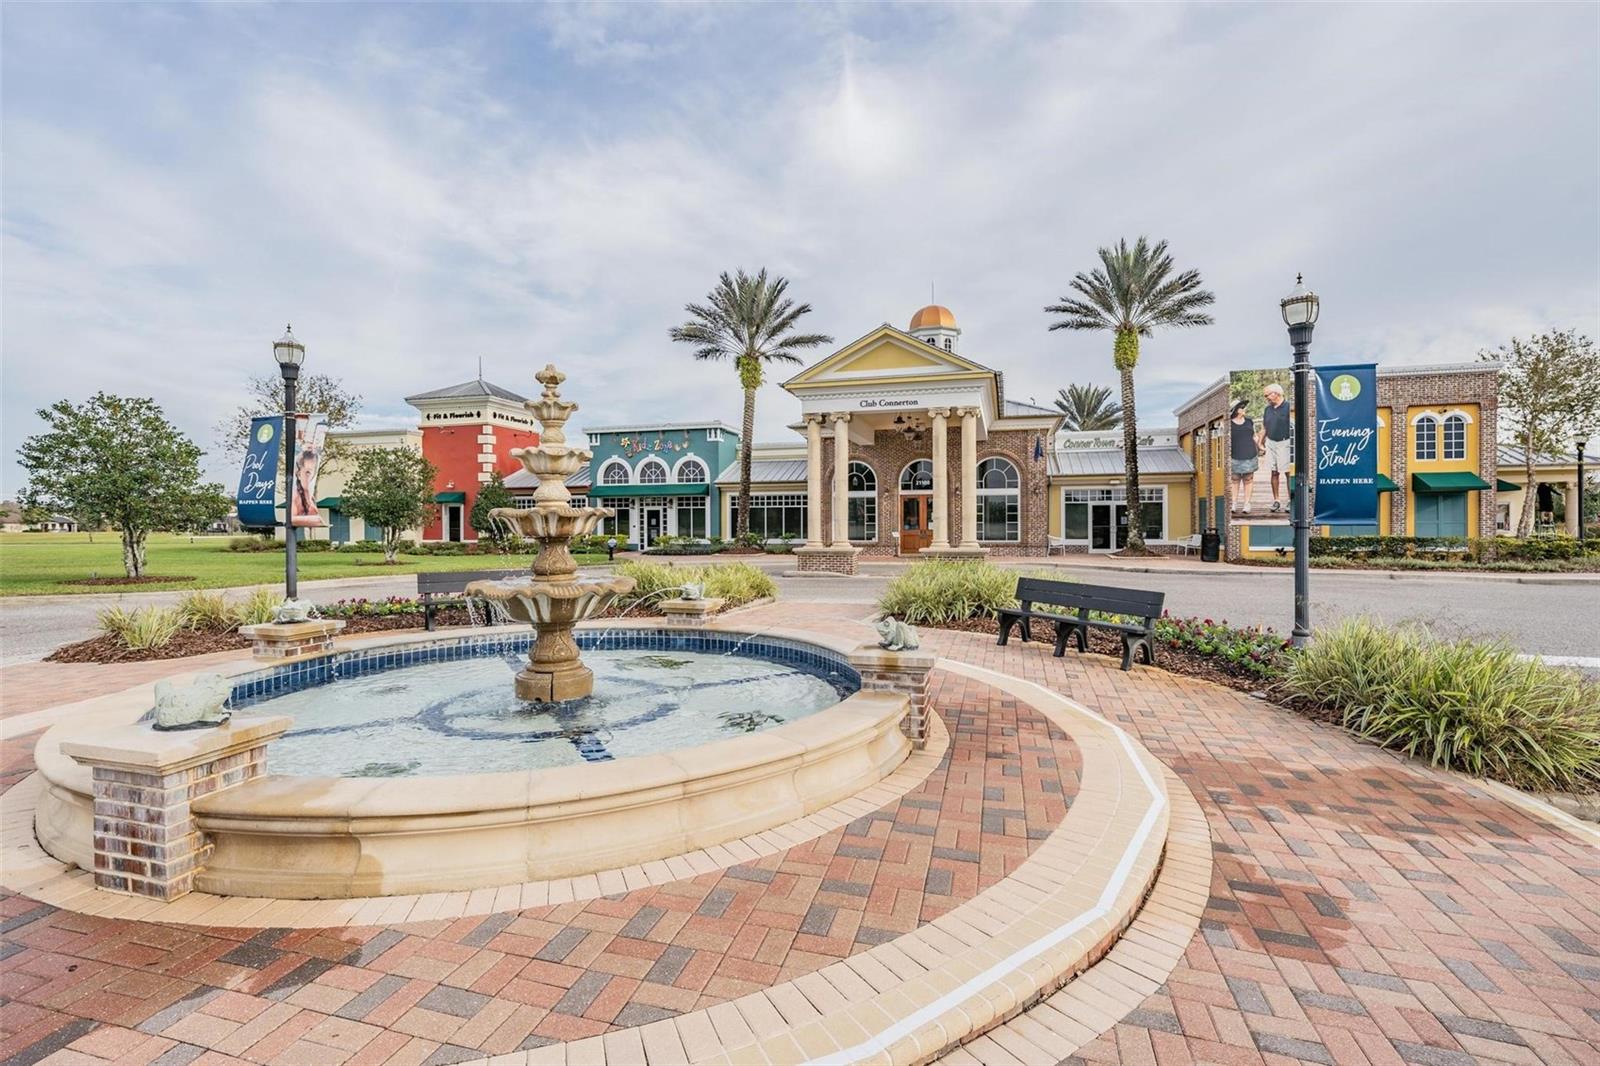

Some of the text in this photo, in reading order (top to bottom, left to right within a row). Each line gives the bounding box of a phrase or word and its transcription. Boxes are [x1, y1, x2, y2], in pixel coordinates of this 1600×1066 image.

[449, 411, 474, 419] Flourish
[859, 399, 919, 408] Club Connerton
[1318, 417, 1374, 451] Evening
[654, 439, 673, 454] Zone
[1318, 443, 1361, 470] Strolls
[242, 451, 268, 474] Pool
[243, 471, 275, 499] Days
